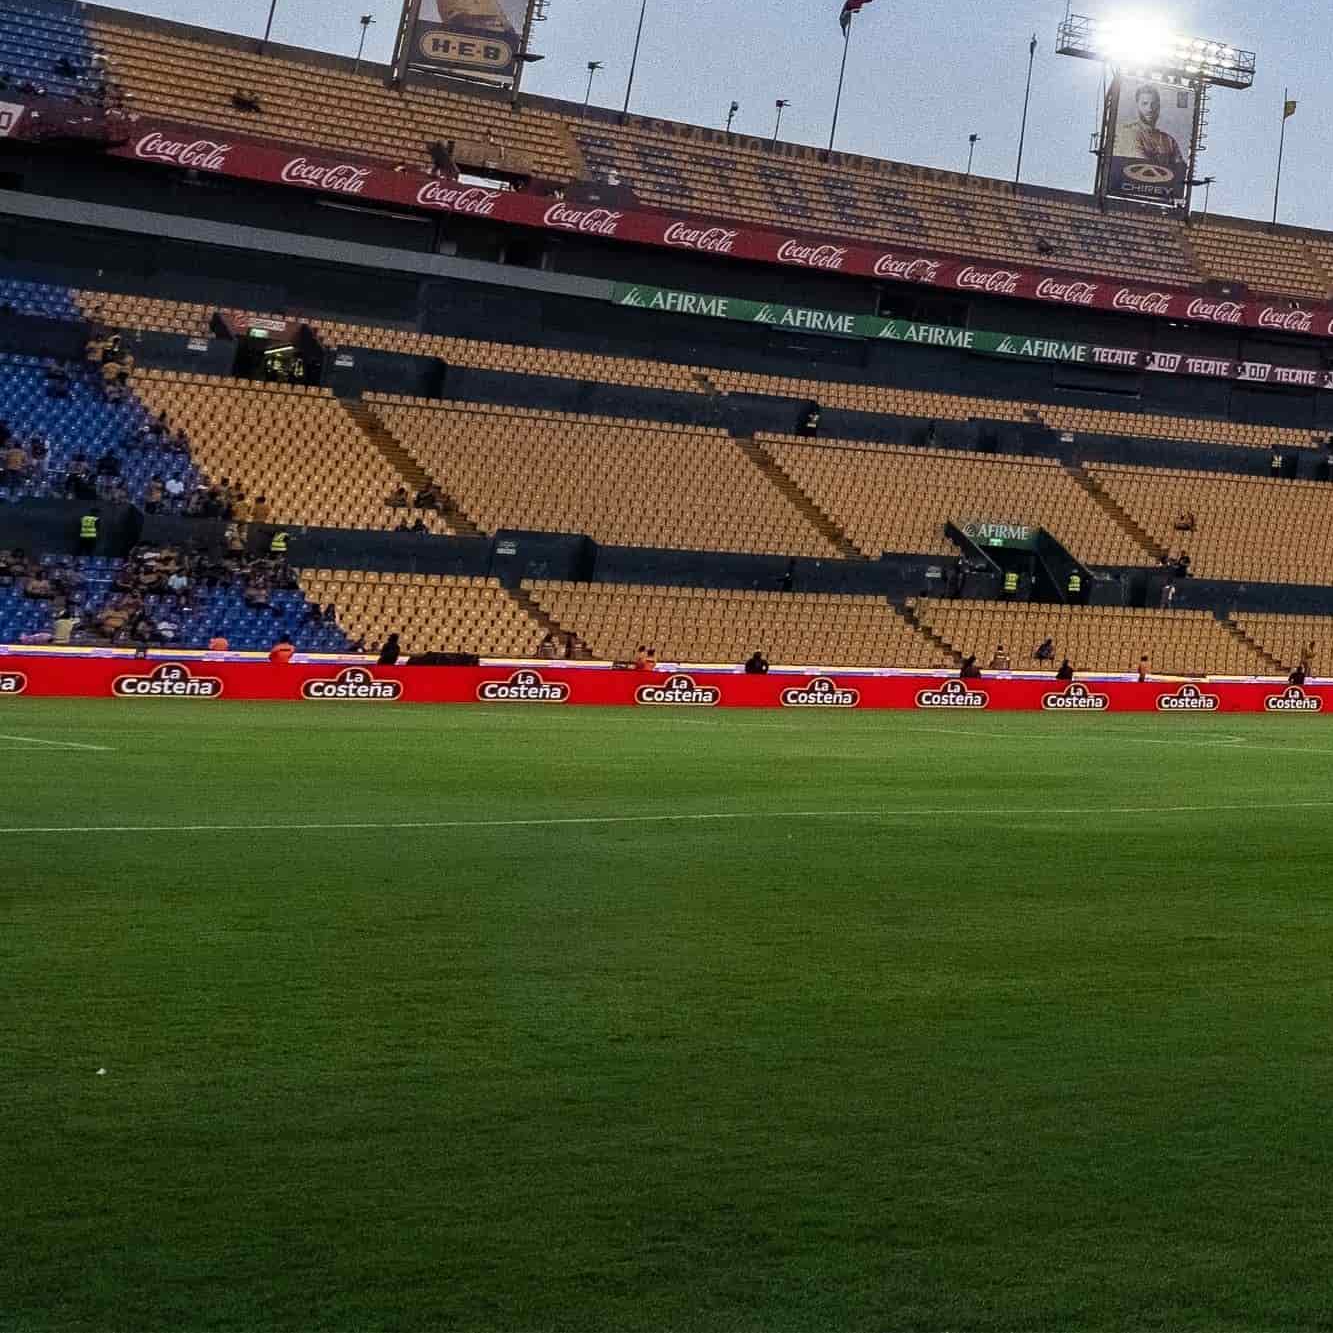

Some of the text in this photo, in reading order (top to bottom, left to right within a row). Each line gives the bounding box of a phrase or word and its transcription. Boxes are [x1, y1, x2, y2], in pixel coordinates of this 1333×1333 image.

[135, 132, 232, 170] Coca-Cola
[281, 156, 371, 194] Coca-Cola
[416, 180, 502, 216] Coca-Cola
[543, 202, 624, 236] Coca-Cola
[663, 221, 739, 254] Coca-Cola
[874, 253, 941, 283] Coca-Ca
[650, 291, 729, 318] AFIRME
[780, 306, 855, 333] AFIRME
[903, 324, 976, 349] AFIRME
[1020, 339, 1087, 362] AFIRME
[1093, 348, 1138, 365] TECATE
[1187, 358, 1230, 376] TECATE
[1275, 367, 1316, 384] TECATE
[161, 667, 181, 679] La
[346, 671, 363, 684] La
[518, 674, 534, 686] La
[121, 678, 213, 696] Costeña
[309, 681, 394, 699] Costeña
[484, 683, 561, 699] Costeña
[672, 677, 687, 689] La
[815, 679, 829, 691] La
[947, 682, 960, 693] La
[1071, 685, 1083, 696] La
[642, 687, 713, 702] Costeña
[787, 689, 852, 704] Costeña
[921, 691, 981, 705] Costeña
[1047, 693, 1103, 707] Costeña
[1184, 687, 1195, 697] La
[1161, 695, 1213, 709] Costeña
[1268, 697, 1317, 710] Costeña
